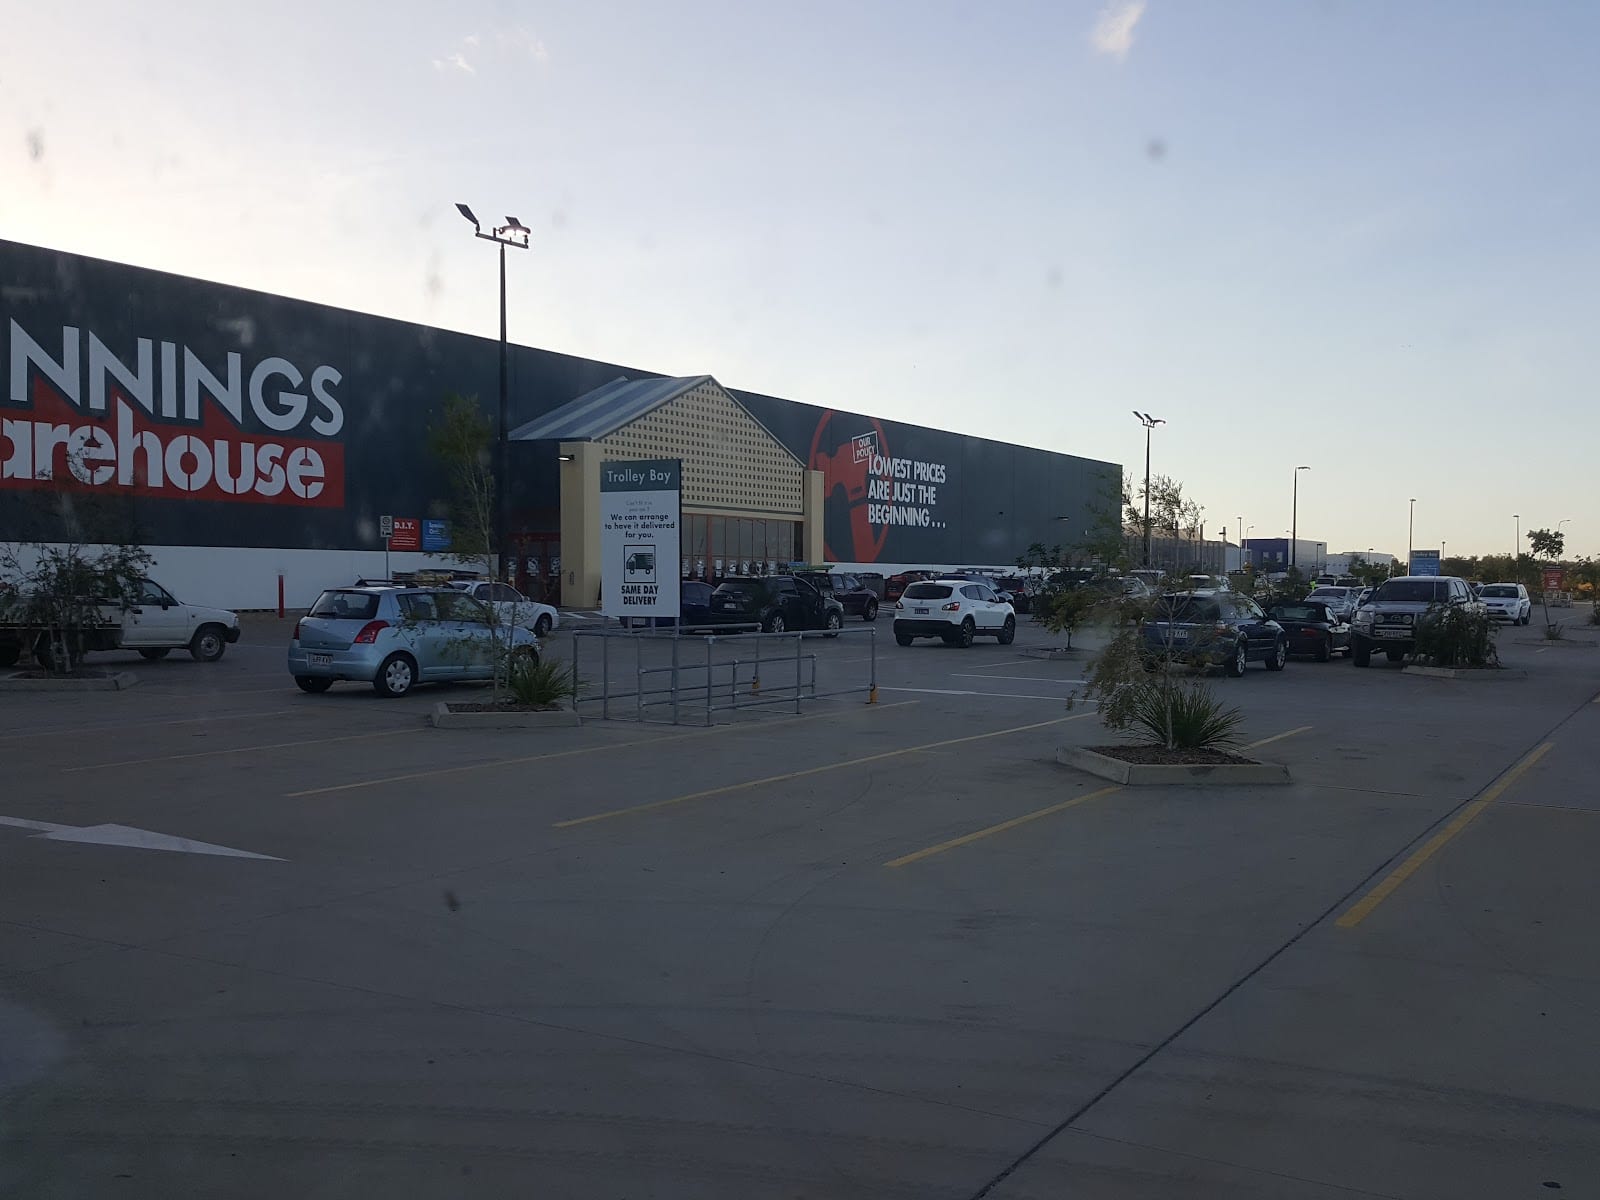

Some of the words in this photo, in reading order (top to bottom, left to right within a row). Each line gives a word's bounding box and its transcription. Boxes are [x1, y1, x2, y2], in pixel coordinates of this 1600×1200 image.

[858, 436, 872, 448] OUR
[856, 444, 876, 459] POLICY
[868, 454, 912, 480] LOWEST
[913, 460, 946, 484] PRICES
[607, 468, 645, 485] Trolley
[649, 468, 671, 484] Bay
[867, 479, 890, 501] ARE
[892, 481, 916, 503] JUST
[917, 485, 937, 505] THE
[610, 513, 623, 521] We
[639, 513, 669, 521] arrange
[614, 522, 632, 530] have
[640, 521, 675, 529] delivered
[637, 532, 654, 540] you.
[621, 585, 642, 595] SAME
[643, 585, 659, 595] DAY
[623, 596, 657, 606] DELIVERY
